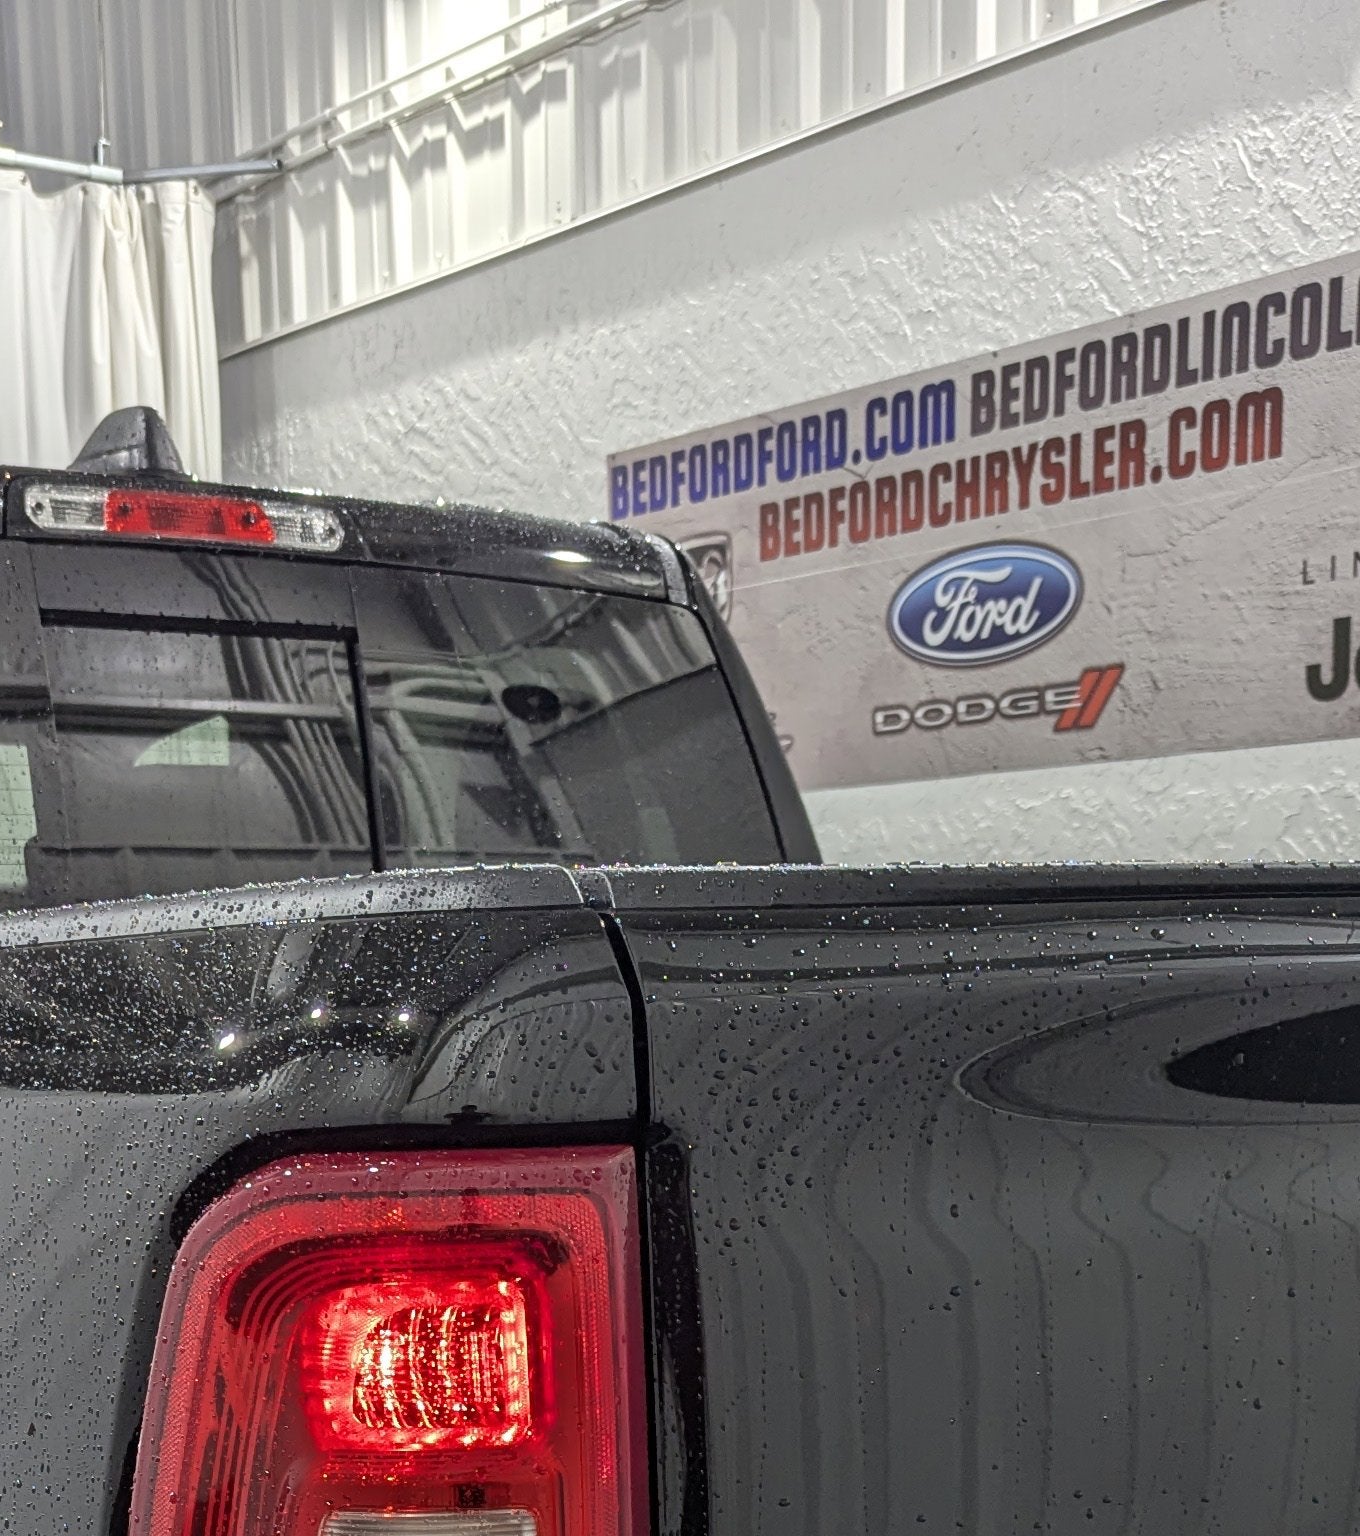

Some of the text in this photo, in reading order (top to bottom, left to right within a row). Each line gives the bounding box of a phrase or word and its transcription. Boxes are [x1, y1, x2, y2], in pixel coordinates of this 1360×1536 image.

[610, 379, 956, 521] BEDFORDFORD.COM
[759, 387, 1284, 562] BEDFORDCHRYSLER.COM
[922, 565, 1043, 647] Ford
[872, 680, 1084, 735] DODGE
